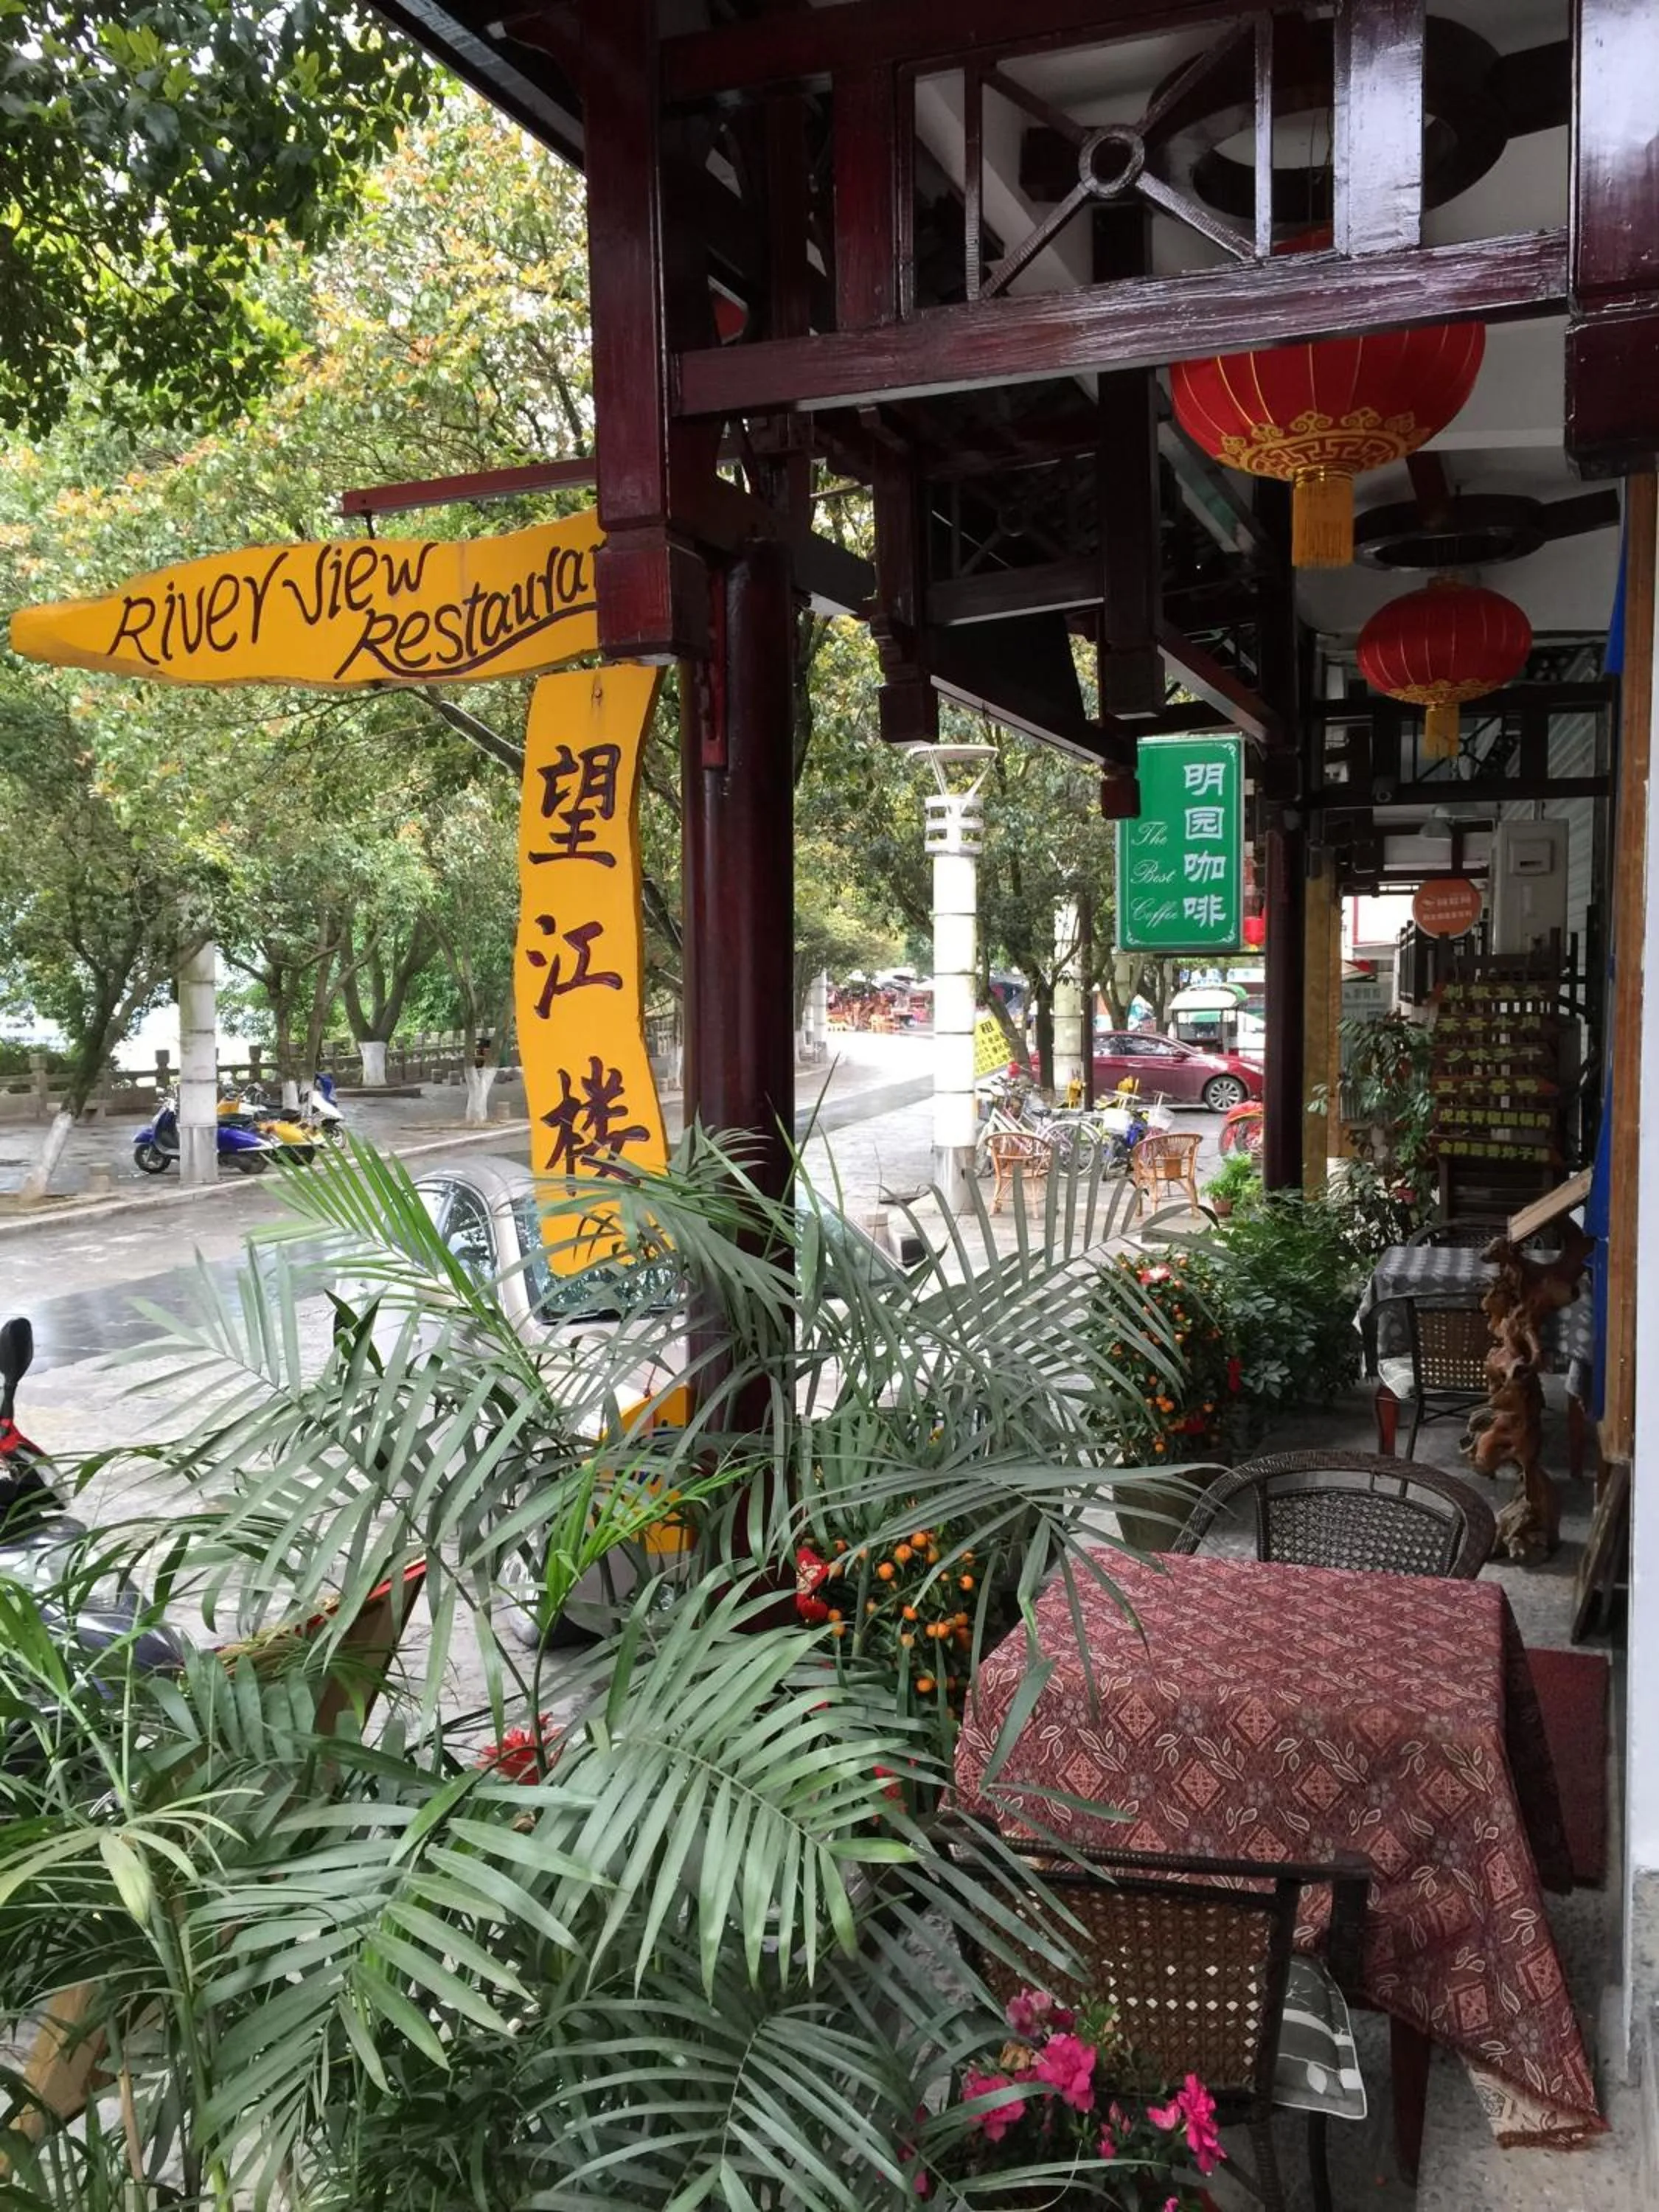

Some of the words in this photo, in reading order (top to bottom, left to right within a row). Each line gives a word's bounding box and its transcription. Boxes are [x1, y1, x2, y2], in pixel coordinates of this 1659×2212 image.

[105, 551, 290, 666] River
[282, 542, 440, 625] View
[334, 540, 608, 680] Restaura
[1130, 859, 1178, 885] Best
[1131, 821, 1168, 846] The
[1183, 762, 1227, 928] 明园咖啡
[526, 743, 650, 1197] 望江楼
[1130, 897, 1178, 928] Coffee
